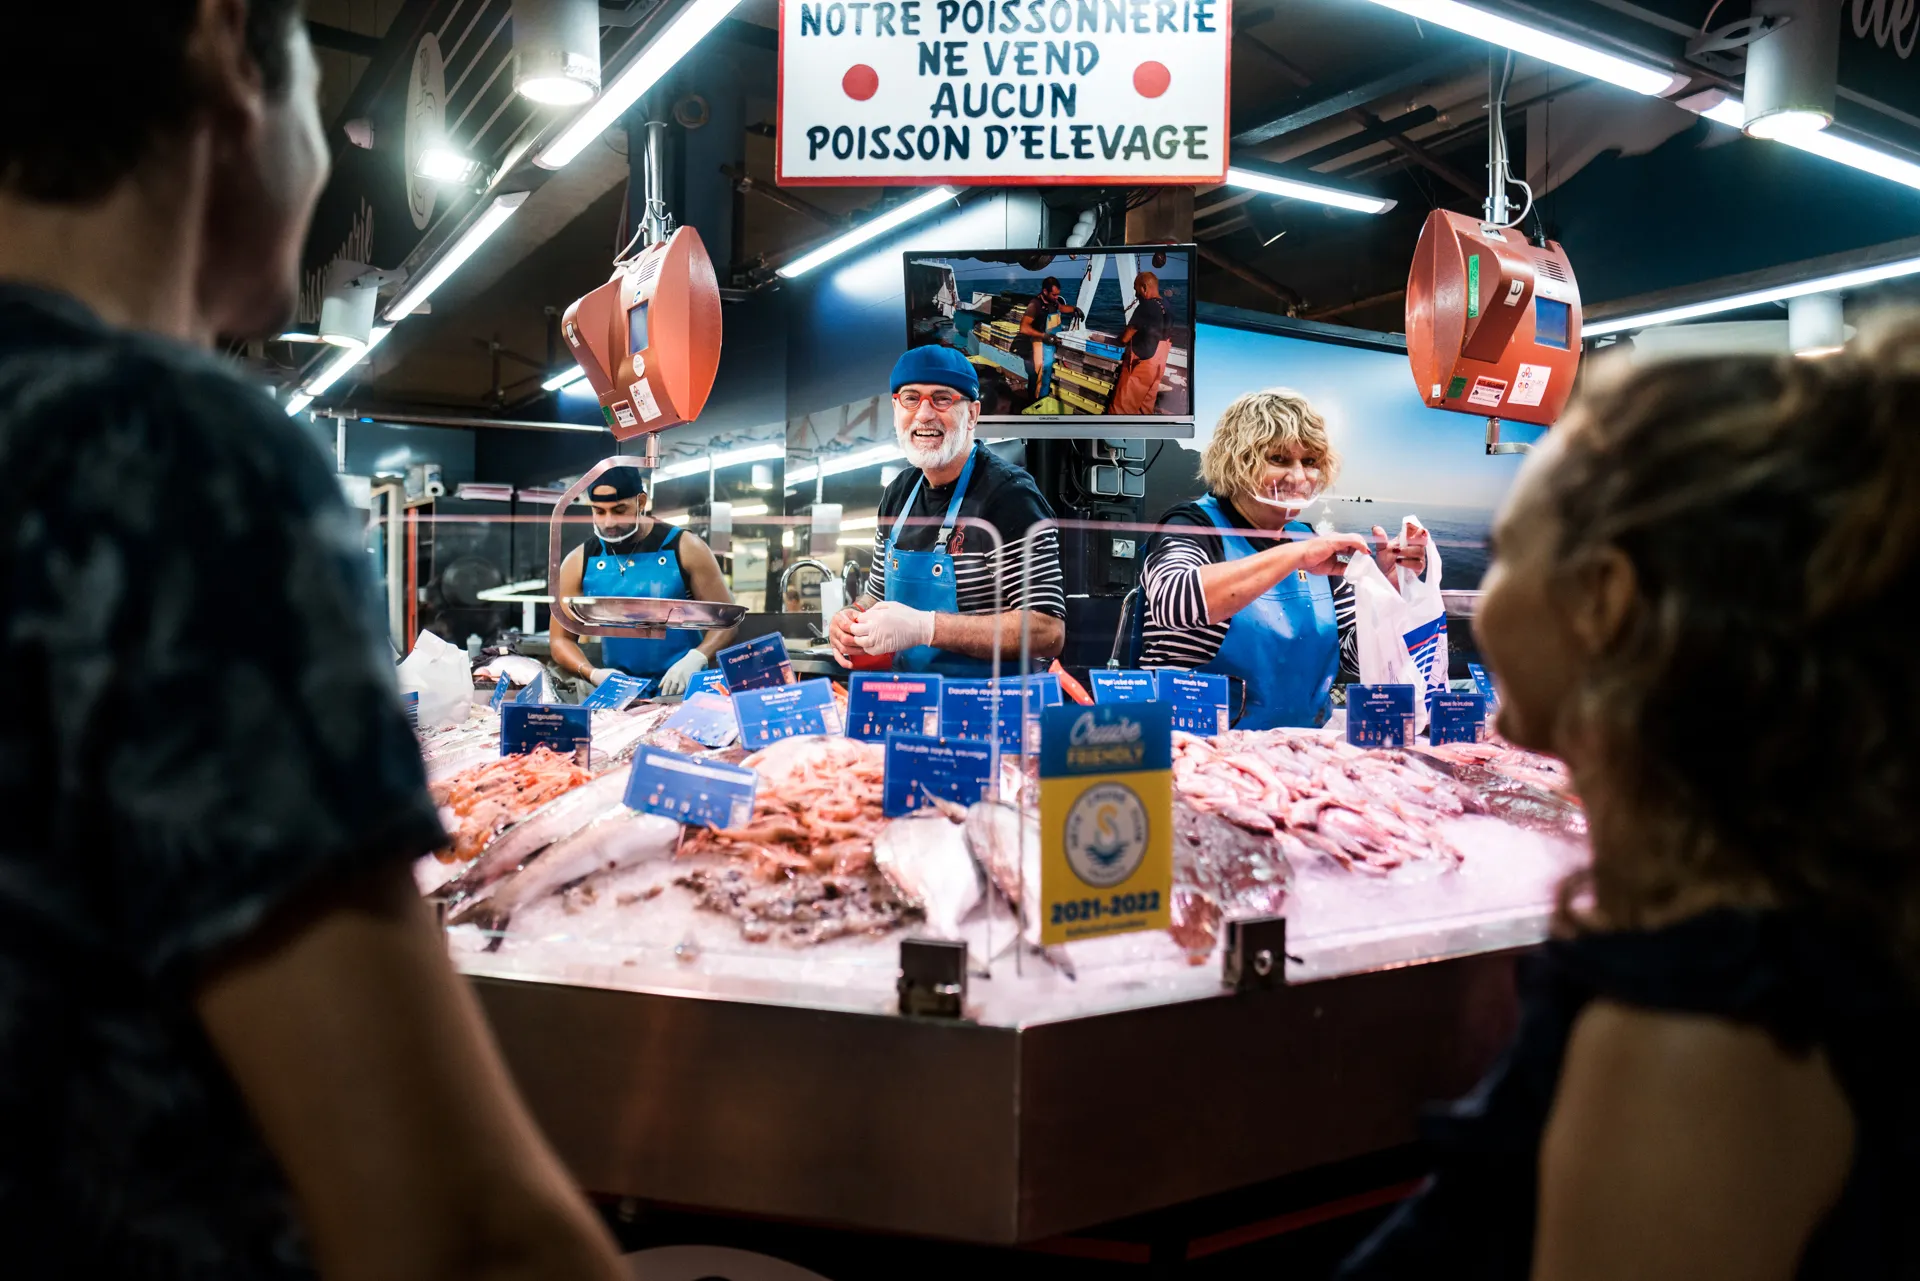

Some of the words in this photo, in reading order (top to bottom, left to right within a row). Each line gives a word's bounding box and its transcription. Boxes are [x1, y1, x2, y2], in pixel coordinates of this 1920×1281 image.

[801, 0, 920, 36] NOTRE
[937, 0, 1216, 34] POISSONNERIE
[918, 41, 968, 76] NE
[983, 40, 1099, 76] VEND
[930, 82, 1076, 118] AUCUN
[806, 125, 970, 161] POISSON
[984, 124, 1208, 160] D'ELEVAGE
[1051, 891, 1161, 926] 2021-2022
